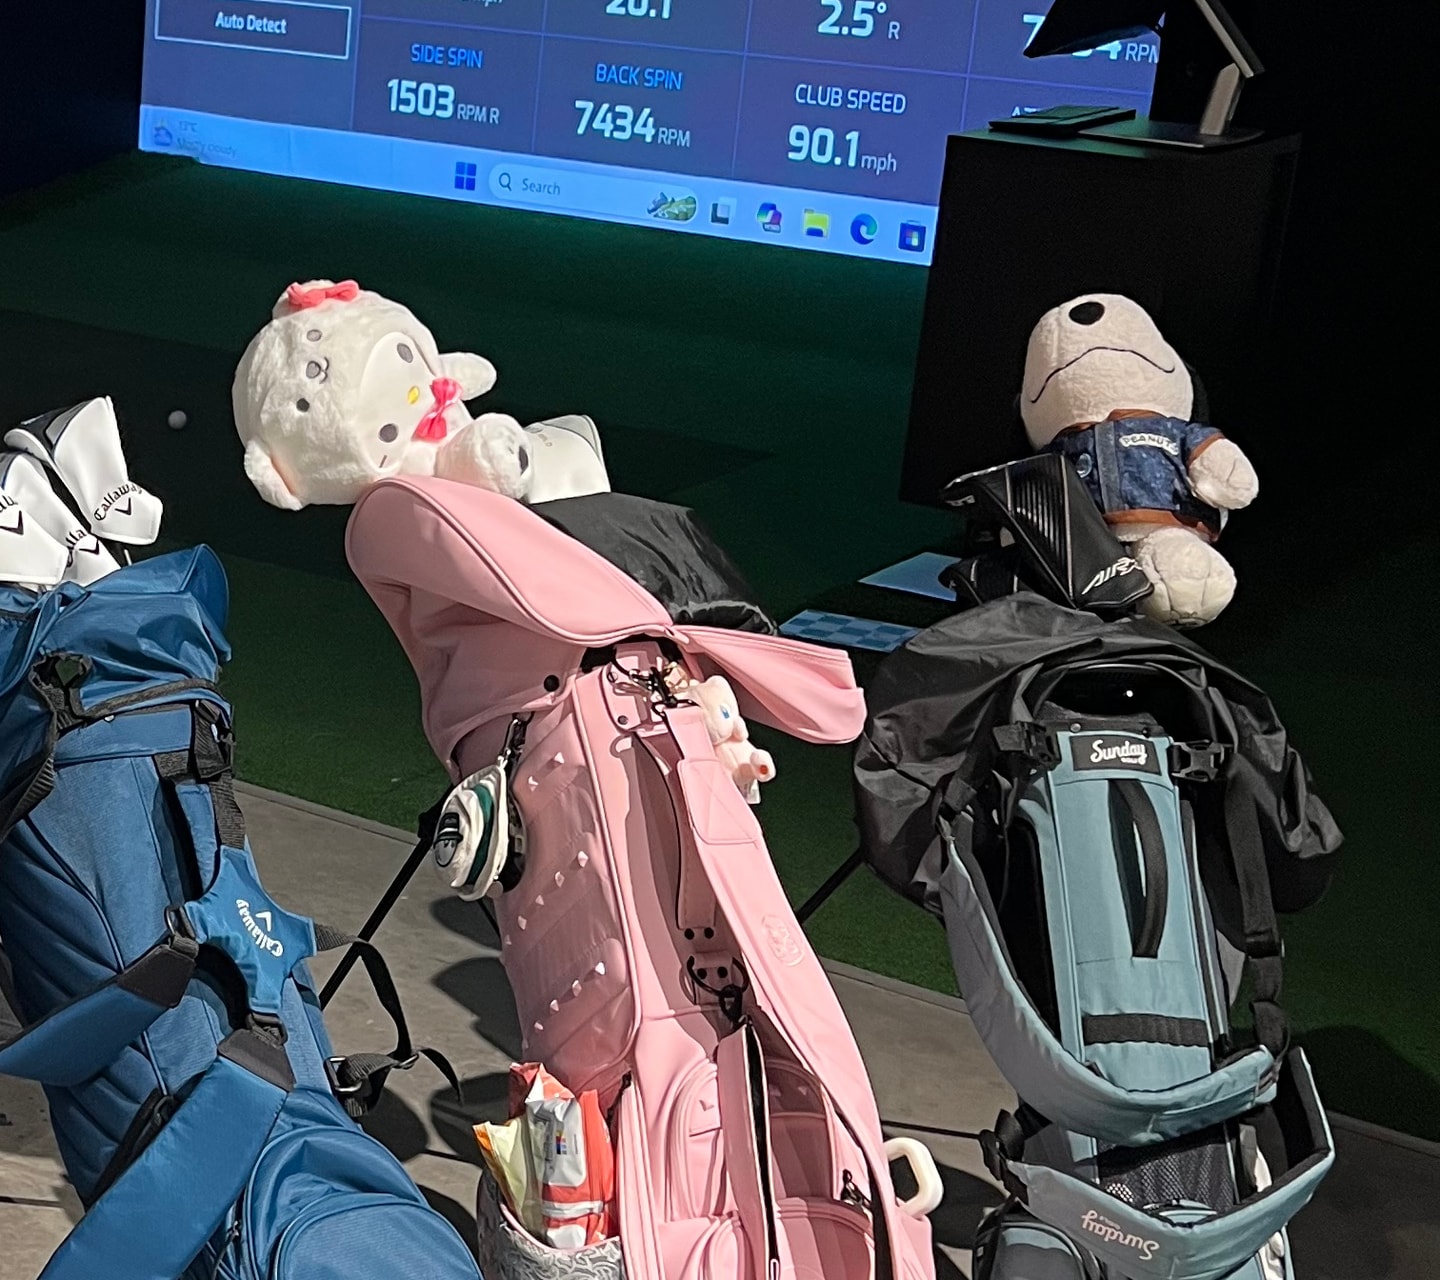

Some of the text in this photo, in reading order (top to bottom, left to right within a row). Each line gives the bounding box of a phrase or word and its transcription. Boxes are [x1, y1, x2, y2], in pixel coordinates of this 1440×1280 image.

[215, 11, 288, 35] Auto Detect
[888, 21, 900, 40] R
[411, 43, 484, 69] SIDE SPIN
[596, 63, 683, 91] BACK SPIN
[387, 79, 499, 125] 1503 RPM R
[795, 83, 906, 114] CLUB SPEED
[574, 99, 691, 148] 7434 RPM
[787, 124, 897, 175] 90.1 mph
[521, 177, 561, 196] Search
[1090, 739, 1148, 765] Sunday
[236, 899, 284, 957] Callaway
[1081, 1210, 1160, 1260] Sunday
